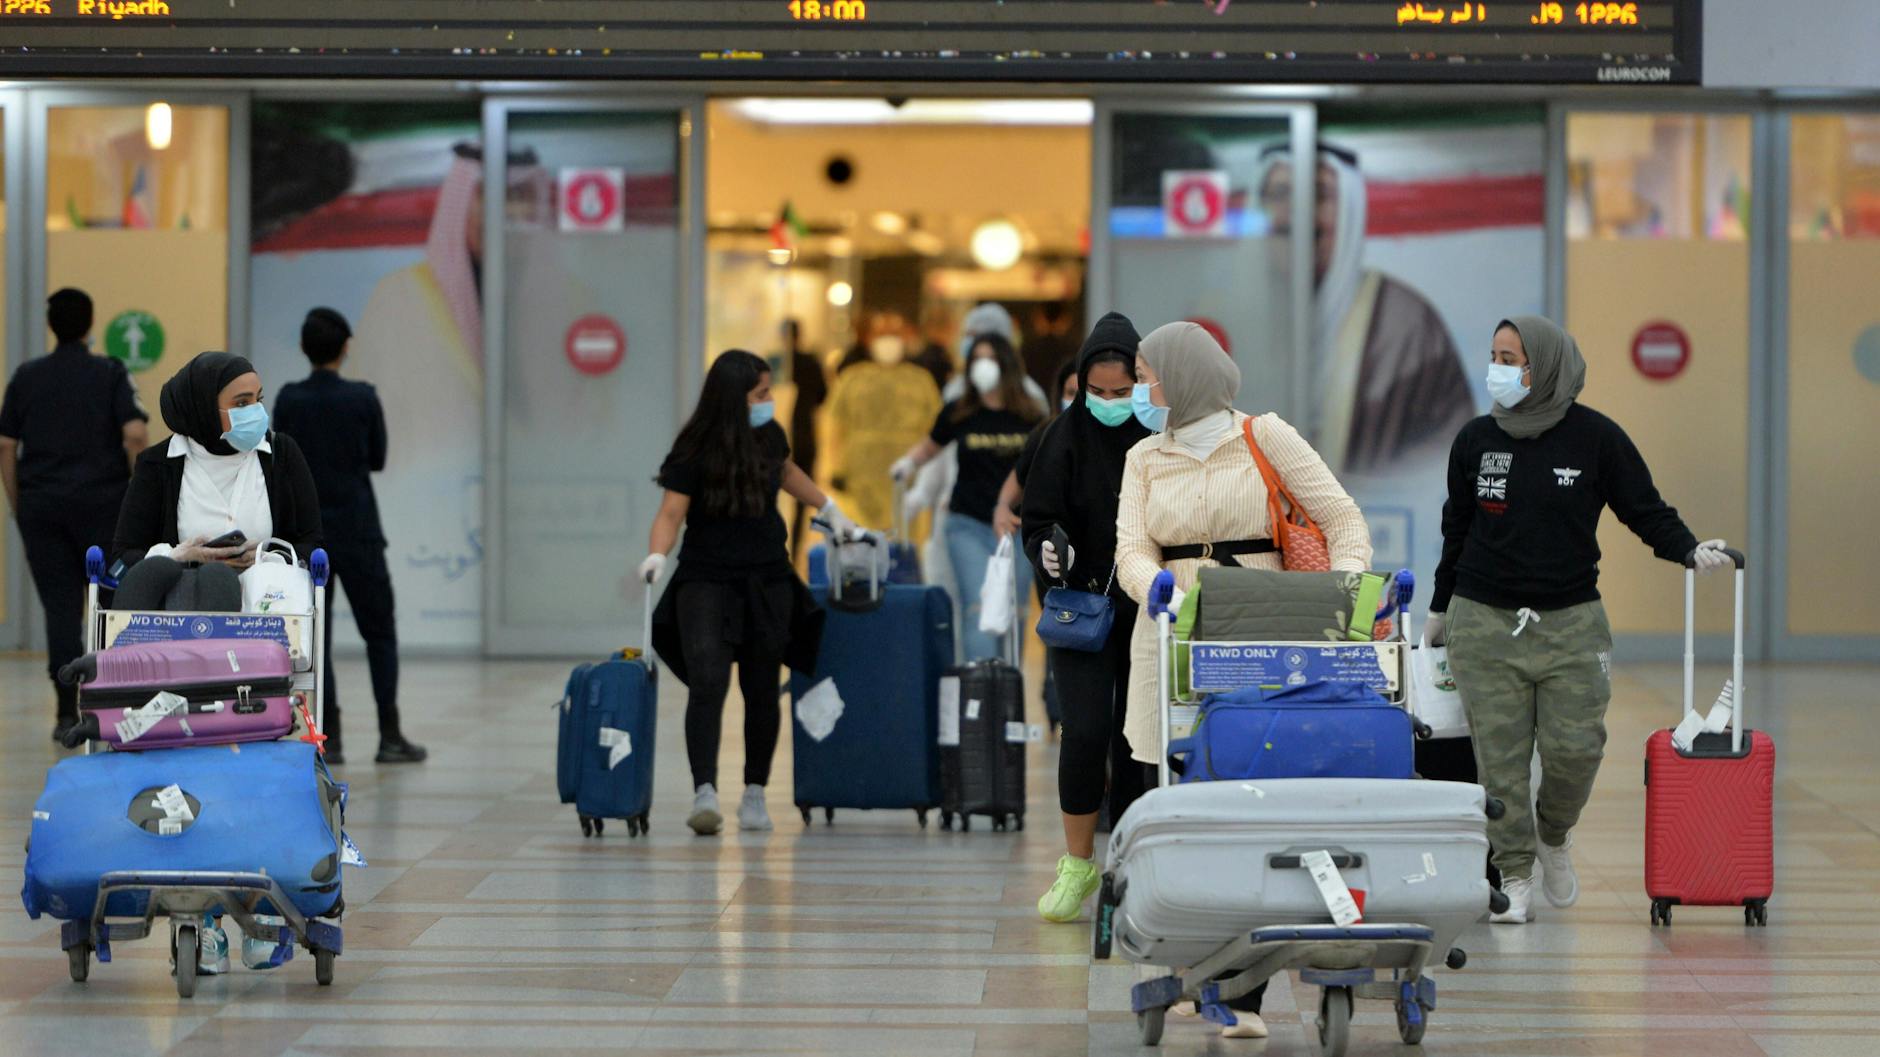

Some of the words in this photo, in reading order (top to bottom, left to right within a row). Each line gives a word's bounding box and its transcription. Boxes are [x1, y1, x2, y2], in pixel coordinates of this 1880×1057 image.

[0, 0, 51, 15] 226
[77, 0, 170, 20] Riyadh
[787, 0, 866, 20] 18:00
[1575, 1, 1638, 25] 1226
[1597, 66, 1671, 81] LEUROCOM
[1557, 477, 1575, 486] BOY
[130, 615, 150, 625] WD
[153, 616, 185, 627] ONLY
[225, 616, 241, 626] فقط
[241, 617, 263, 630] كويتي
[263, 617, 282, 629] دينار
[1199, 648, 1205, 658] 1
[1209, 648, 1241, 658] KWD
[1243, 648, 1278, 658] ONLY
[1319, 647, 1337, 657] فقط
[1338, 647, 1361, 660] كويتي
